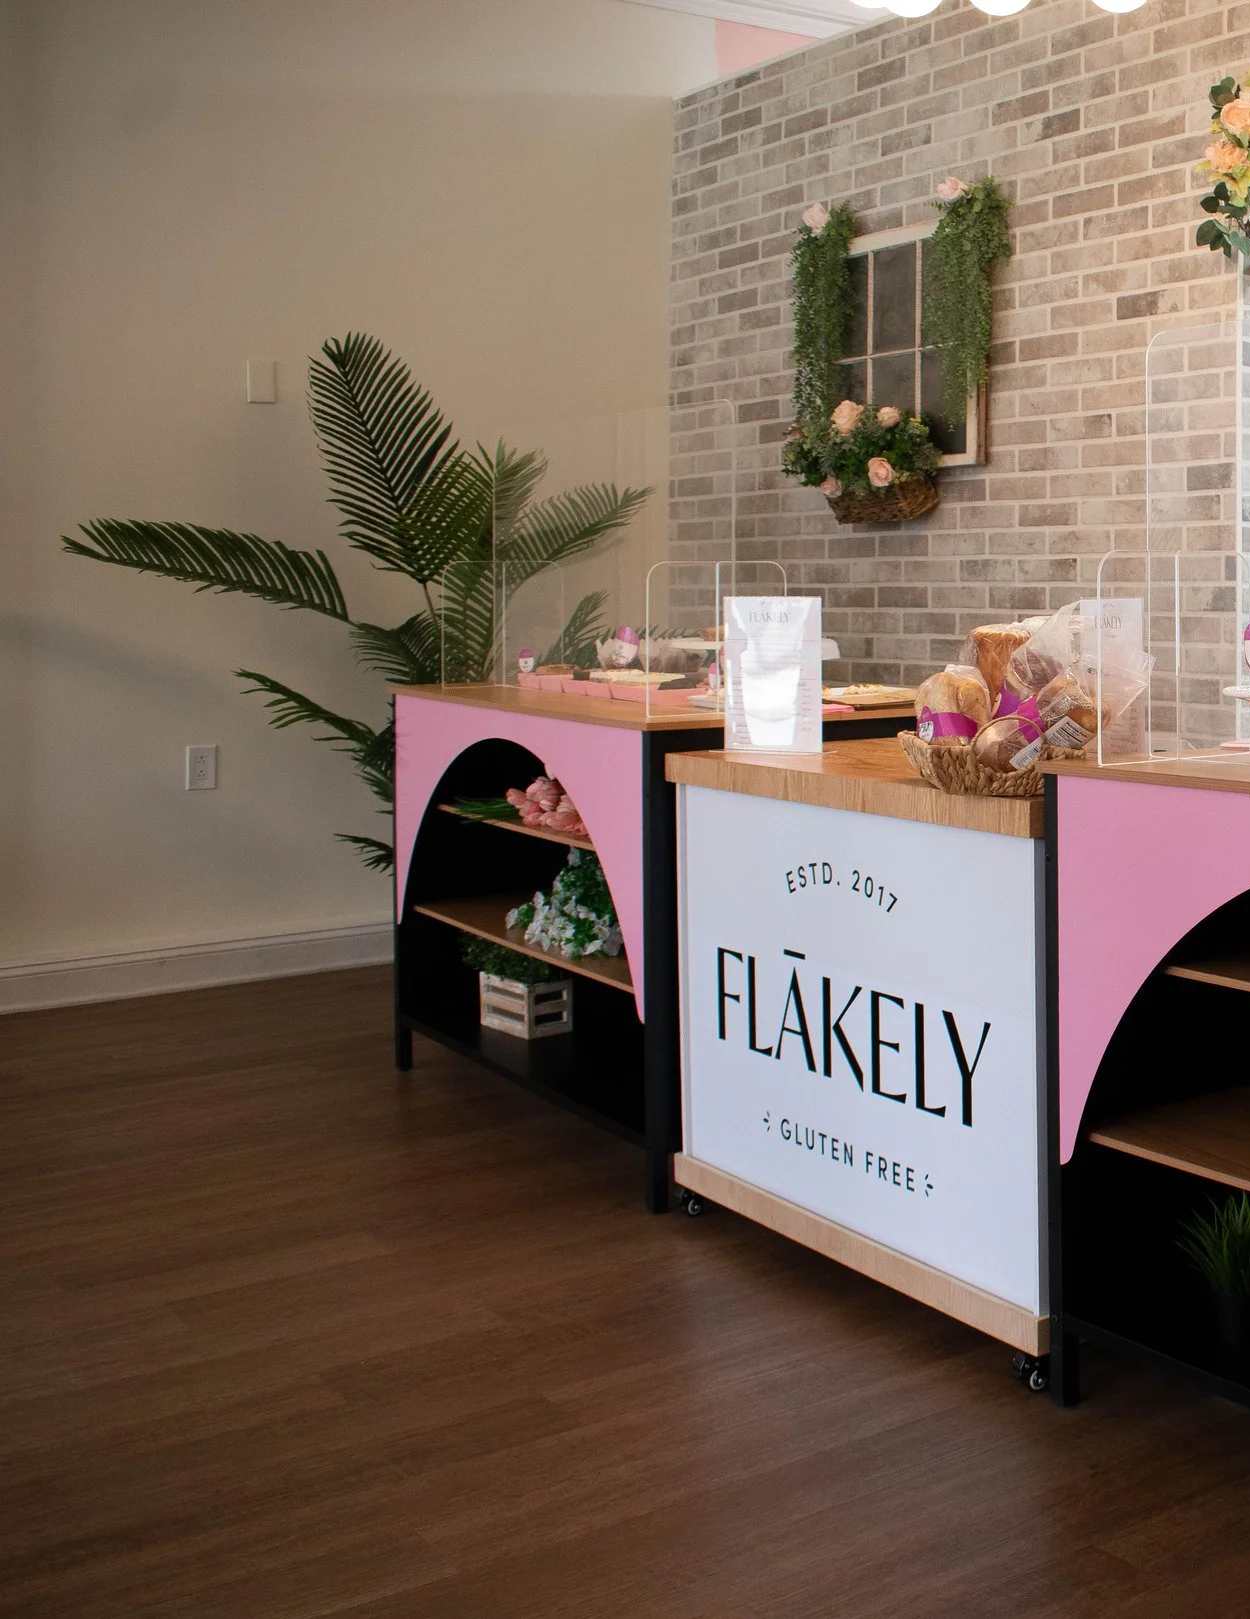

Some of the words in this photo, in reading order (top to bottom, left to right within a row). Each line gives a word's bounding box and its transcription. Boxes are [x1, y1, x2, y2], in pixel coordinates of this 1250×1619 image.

[785, 861, 841, 894] ESTD.
[851, 869, 899, 914] 2017
[716, 946, 992, 1128] FLĀKELY
[780, 1117, 855, 1168] GLUTEN
[865, 1151, 916, 1193] FREE
